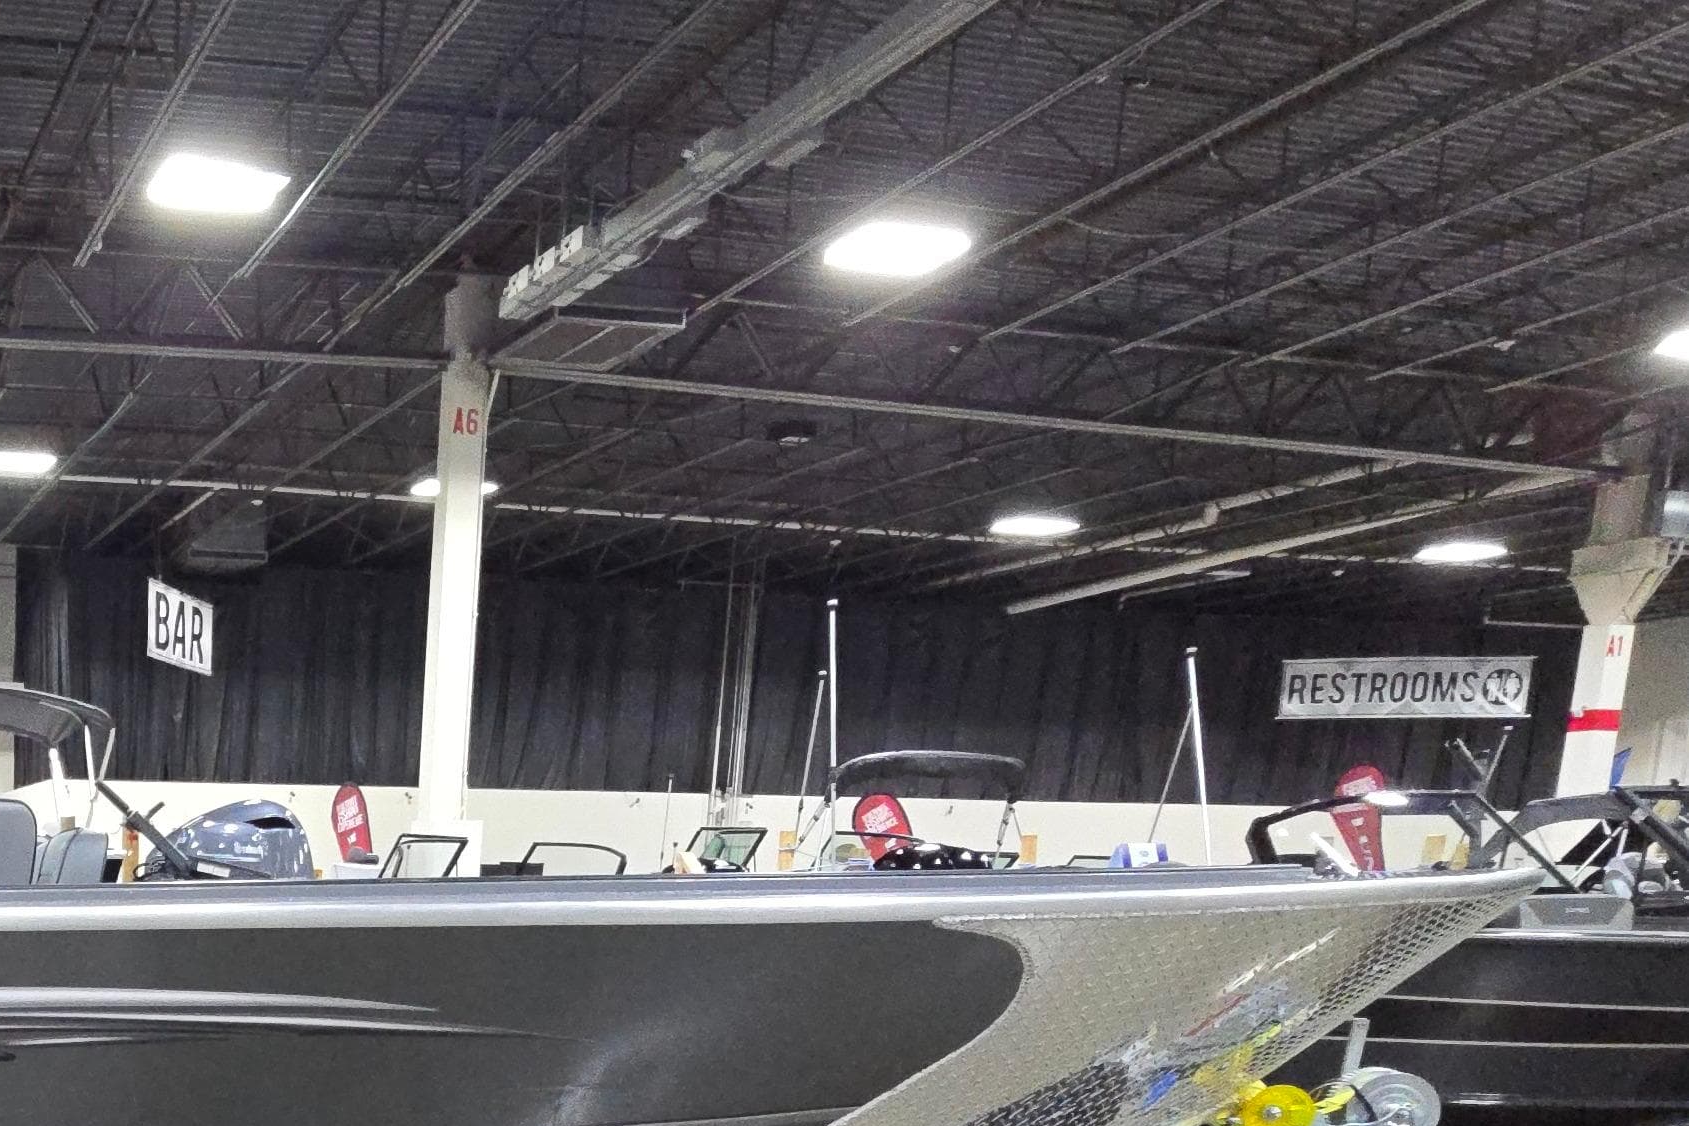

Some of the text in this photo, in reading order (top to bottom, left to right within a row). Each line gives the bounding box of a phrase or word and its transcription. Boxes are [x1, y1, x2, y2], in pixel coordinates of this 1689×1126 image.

[453, 406, 479, 435] A6
[155, 590, 204, 664] BAR
[1606, 634, 1623, 657] A1
[1287, 671, 1481, 705] RESTROOMS
